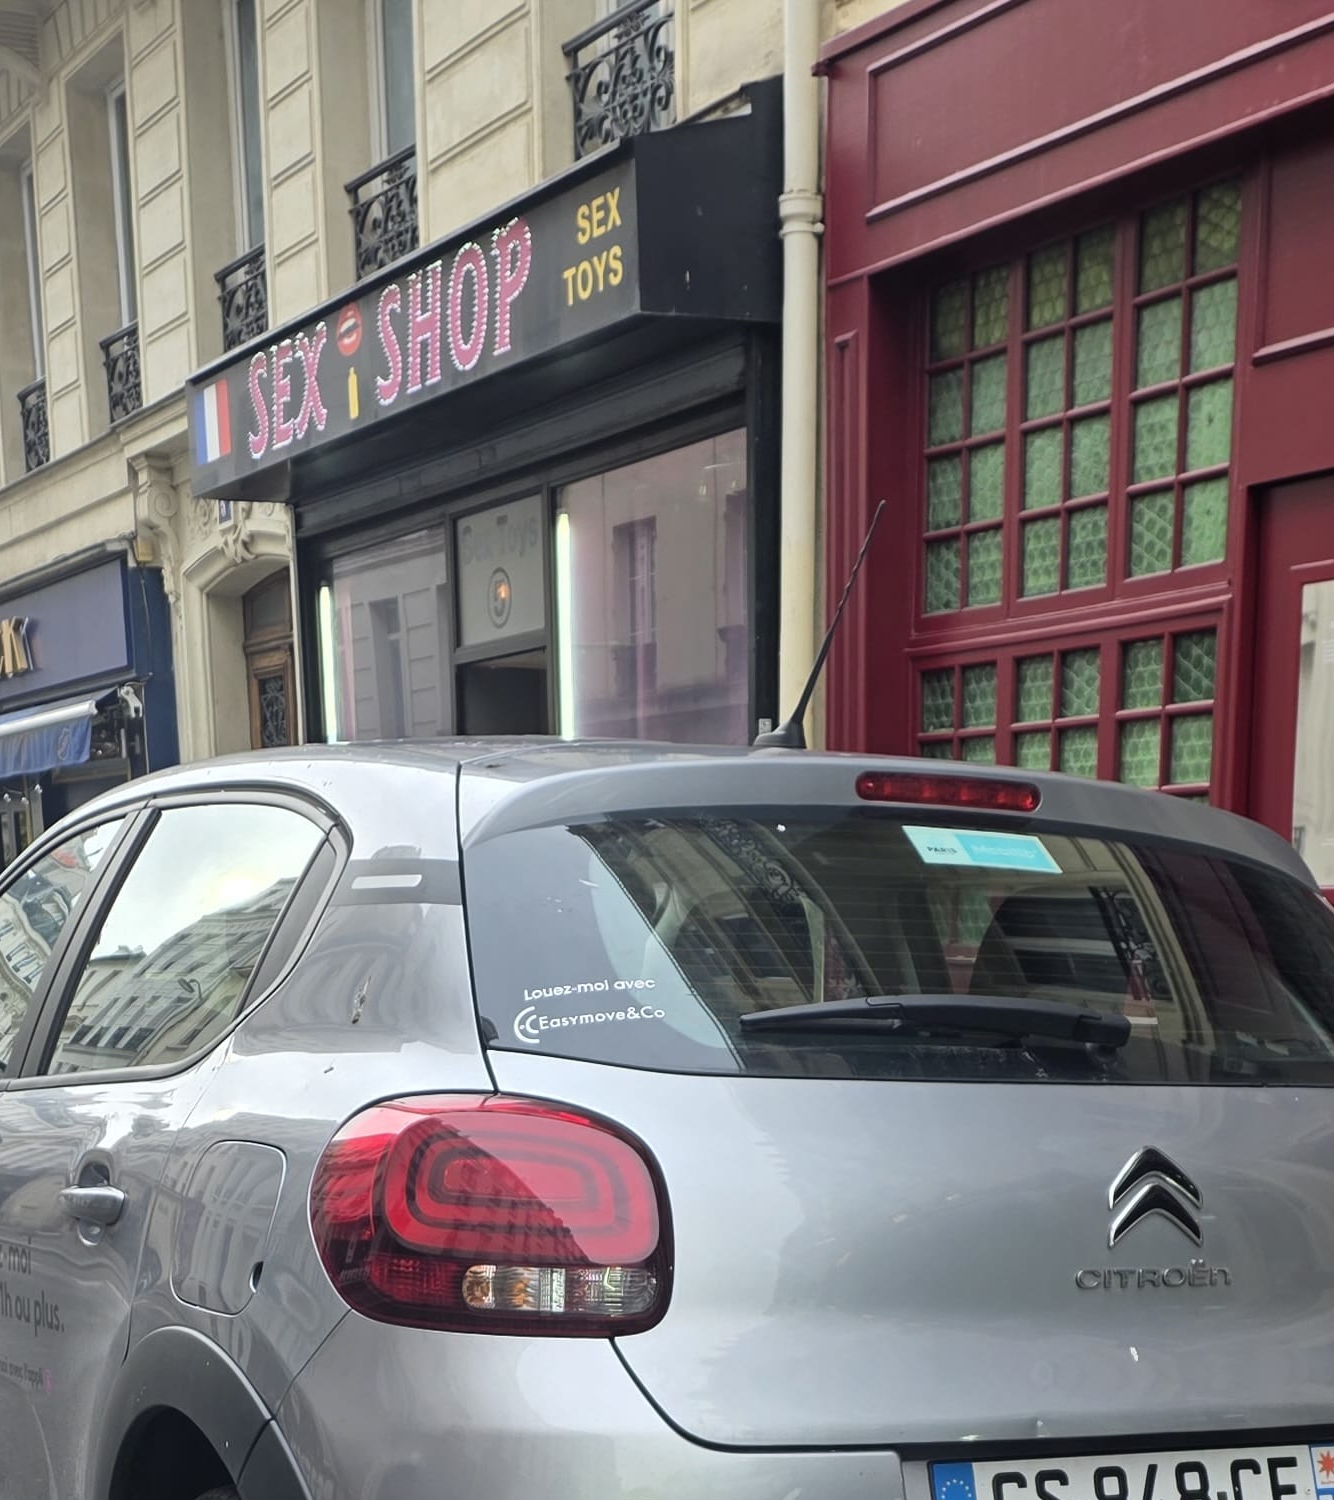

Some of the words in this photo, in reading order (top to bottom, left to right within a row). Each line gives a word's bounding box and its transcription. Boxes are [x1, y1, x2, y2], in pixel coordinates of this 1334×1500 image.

[576, 187, 622, 245] SEX
[563, 245, 624, 307] TOYS
[247, 321, 327, 460] SEX
[375, 216, 533, 407] SHOP
[524, 979, 609, 1001] Louez-moi
[613, 979, 655, 990] avec
[538, 1005, 666, 1030] Easymove&Co
[14, 1295, 31, 1323] ou
